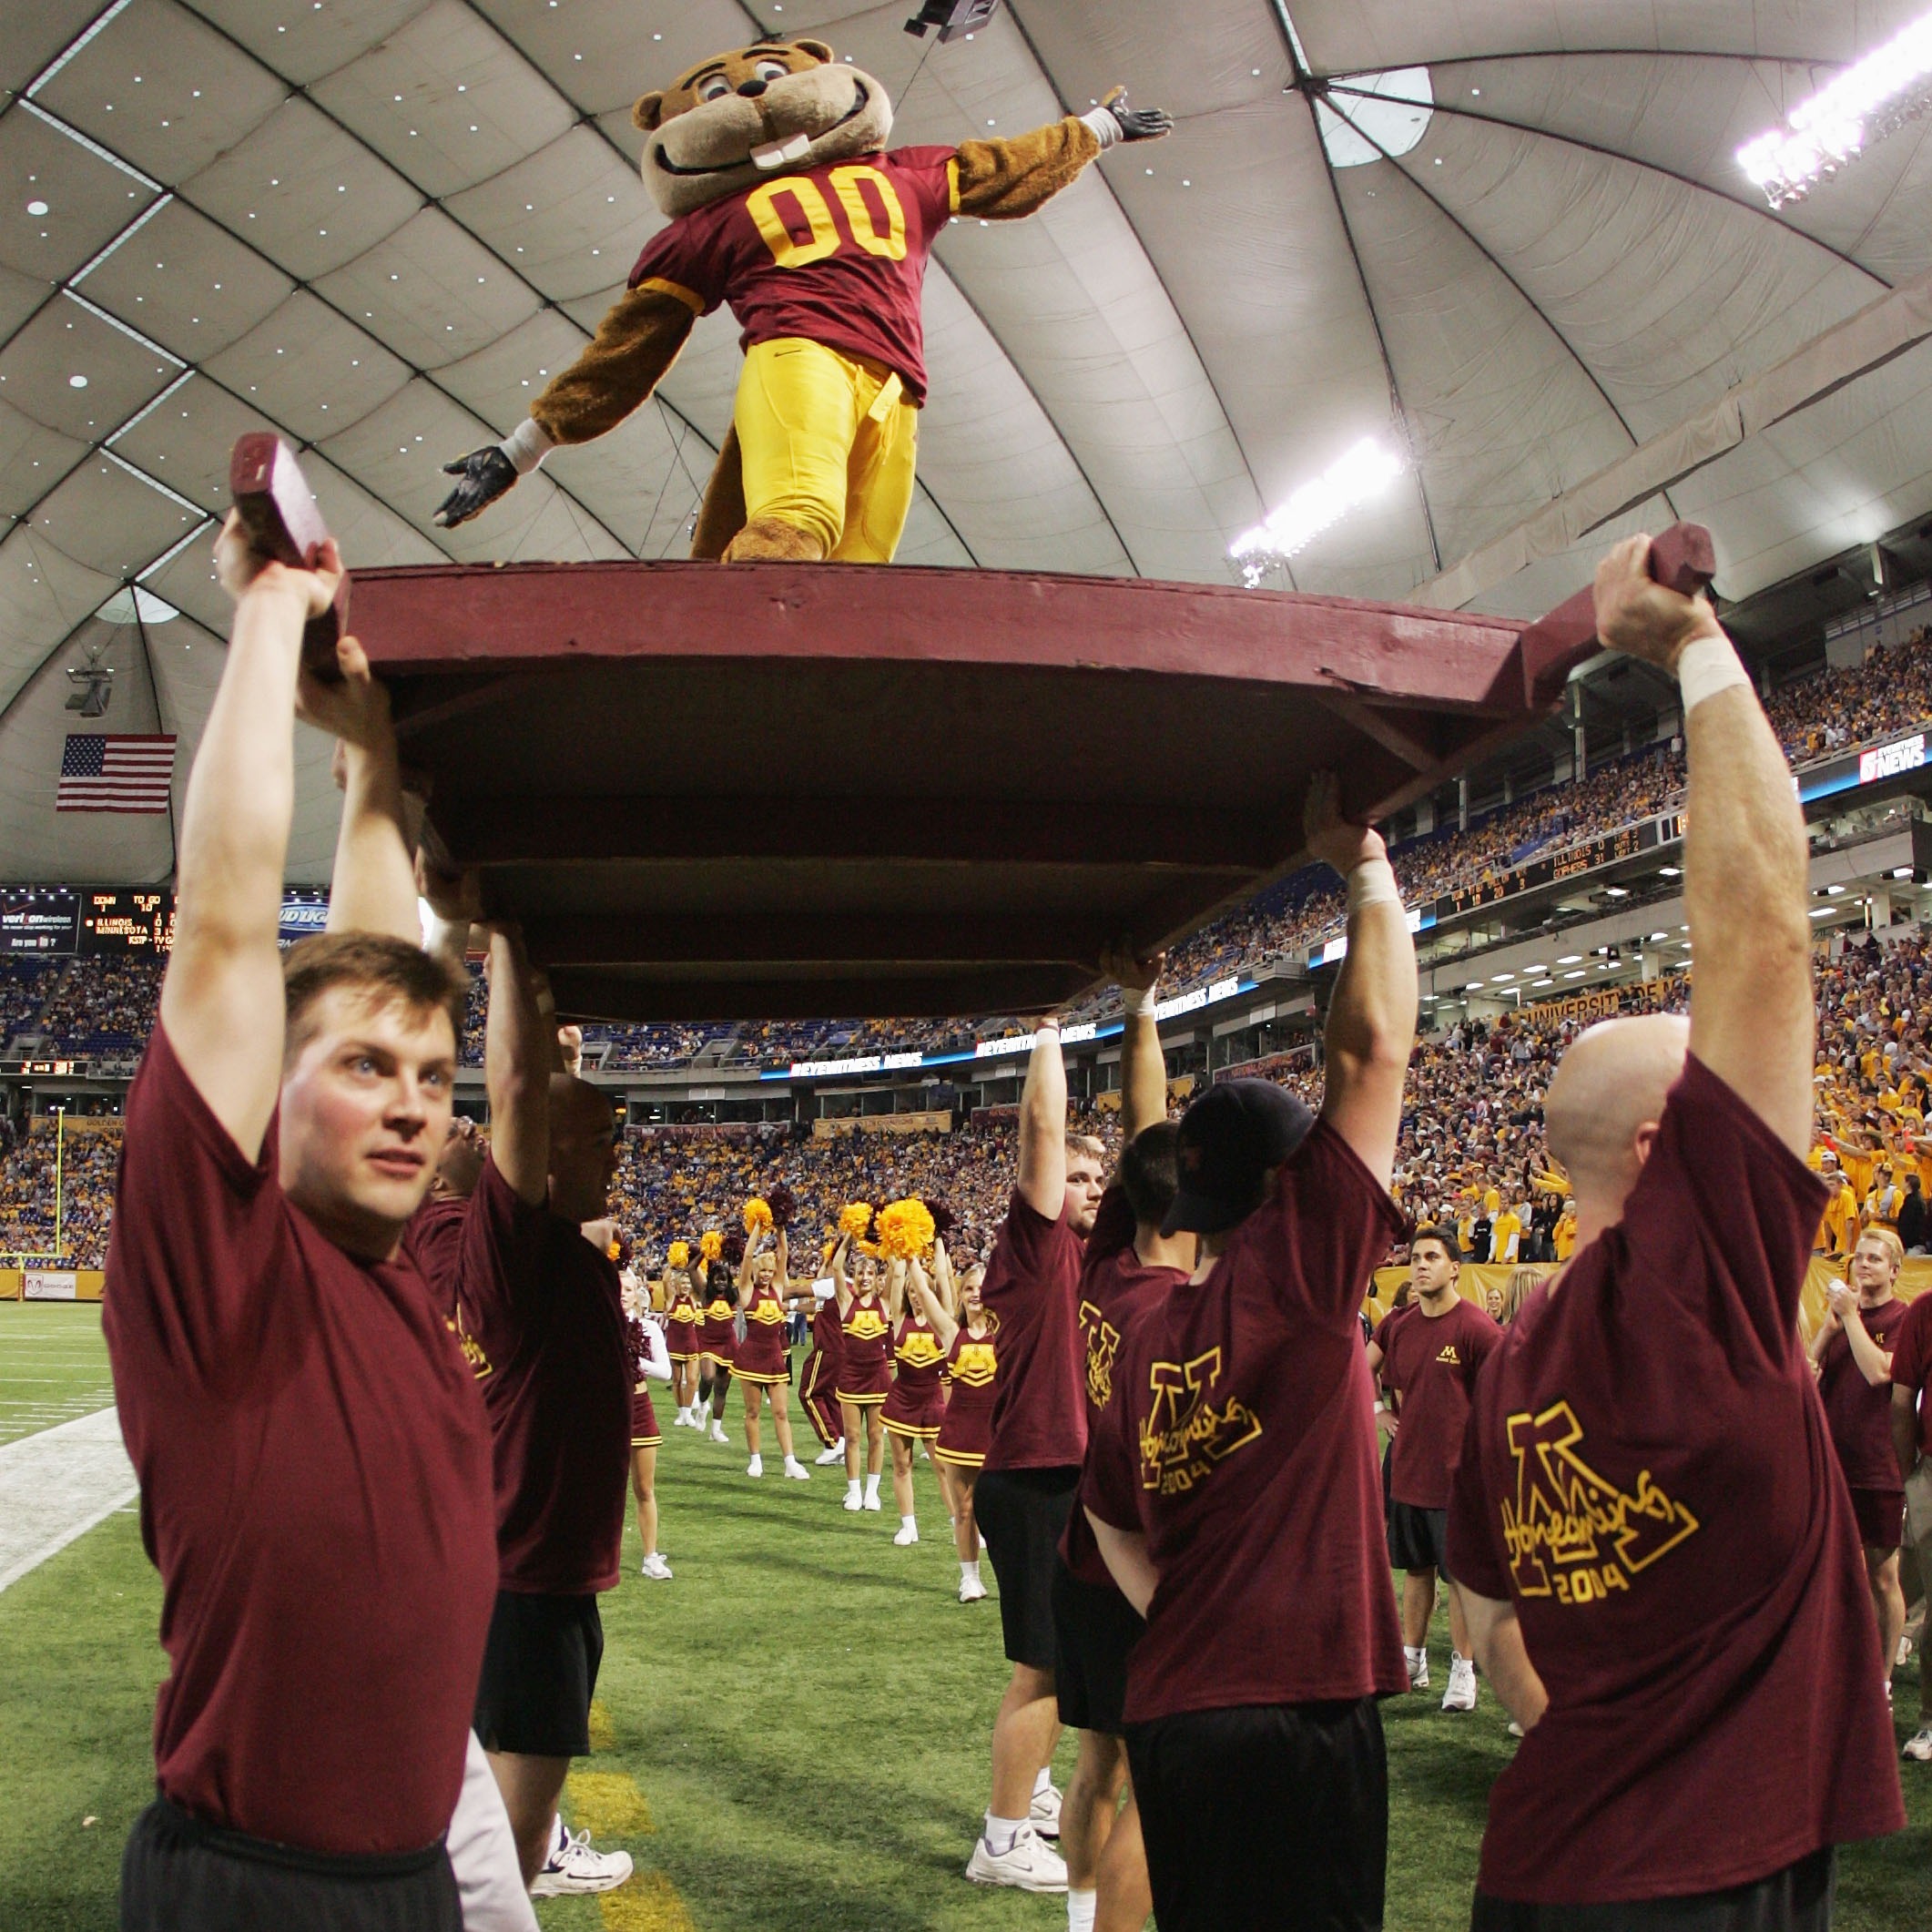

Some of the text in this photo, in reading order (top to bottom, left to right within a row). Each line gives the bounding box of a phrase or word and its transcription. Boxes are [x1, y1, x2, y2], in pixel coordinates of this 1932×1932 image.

[746, 166, 907, 269] 00
[1876, 745, 1925, 779] NEWS
[1633, 840, 1640, 851] 2
[1553, 844, 1591, 868] ILLINOIS
[1553, 852, 1605, 880] GOPHERS 31
[1494, 885, 1504, 900] 20
[93, 895, 116, 905] DOWN
[133, 895, 145, 904] TO
[147, 895, 160, 905] GO
[141, 904, 152, 912] 10
[97, 918, 133, 927] ILLINOIS
[279, 910, 329, 923] UD LIG
[96, 926, 147, 935] MINNESOTA
[11, 938, 23, 946] Are
[24, 939, 36, 947] you
[1154, 976, 1238, 1021] YEWITNESS NEWS
[985, 1033, 1037, 1055] EYEWITN
[1060, 1023, 1096, 1044] NEWS
[801, 1055, 880, 1076] EYEWITNESS
[883, 1052, 922, 1069] NEWS
[1440, 1345, 1457, 1358] M
